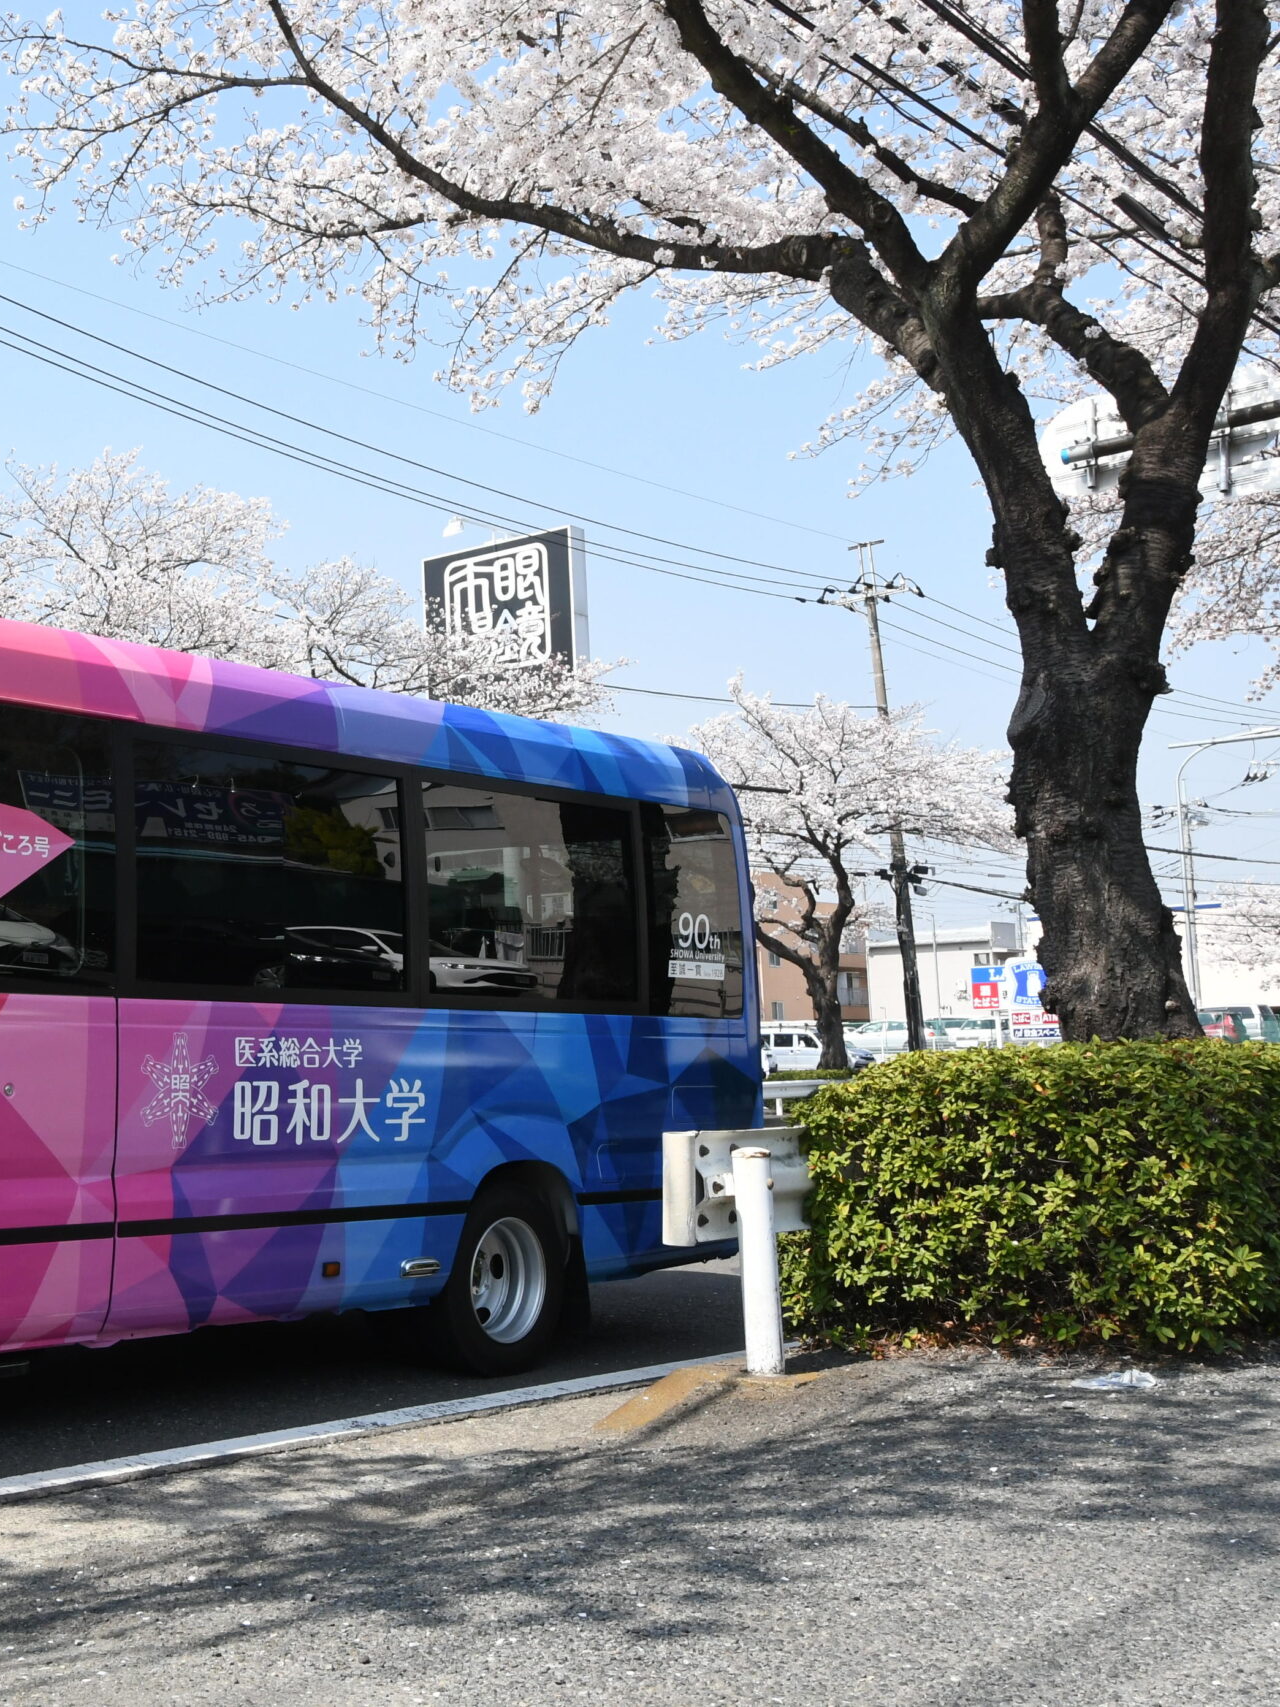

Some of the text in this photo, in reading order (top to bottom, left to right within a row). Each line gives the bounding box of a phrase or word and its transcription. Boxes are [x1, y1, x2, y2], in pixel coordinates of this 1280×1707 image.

[678, 912, 721, 949] 90th
[670, 949, 725, 963] SHOWA University
[234, 1037, 363, 1069] 医系総合大学
[233, 1078, 425, 1146] 昭和大学
